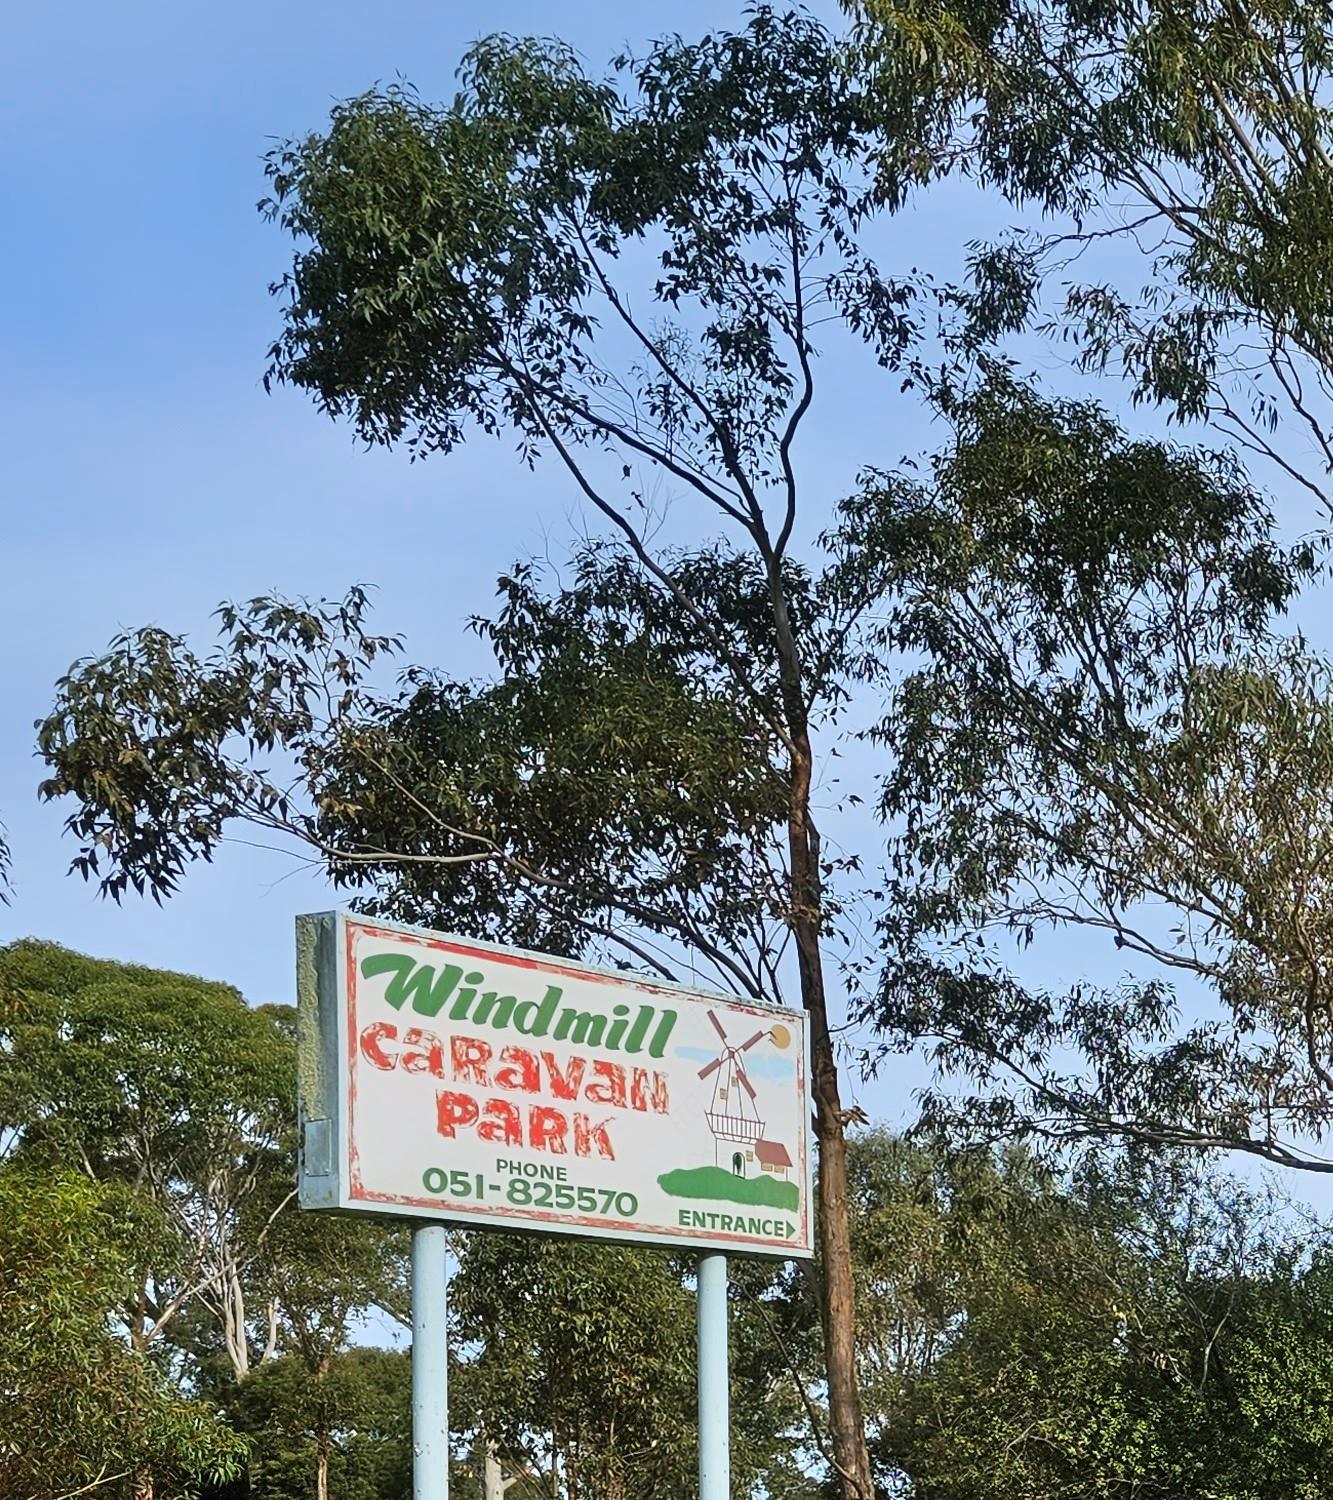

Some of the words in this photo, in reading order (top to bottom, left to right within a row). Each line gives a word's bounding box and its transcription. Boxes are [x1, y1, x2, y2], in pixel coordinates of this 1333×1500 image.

[360, 952, 678, 1059] Windmill
[495, 1158, 568, 1182] PHONE
[421, 1166, 639, 1217] 051-825570
[678, 1208, 785, 1238] ENTRANCE
